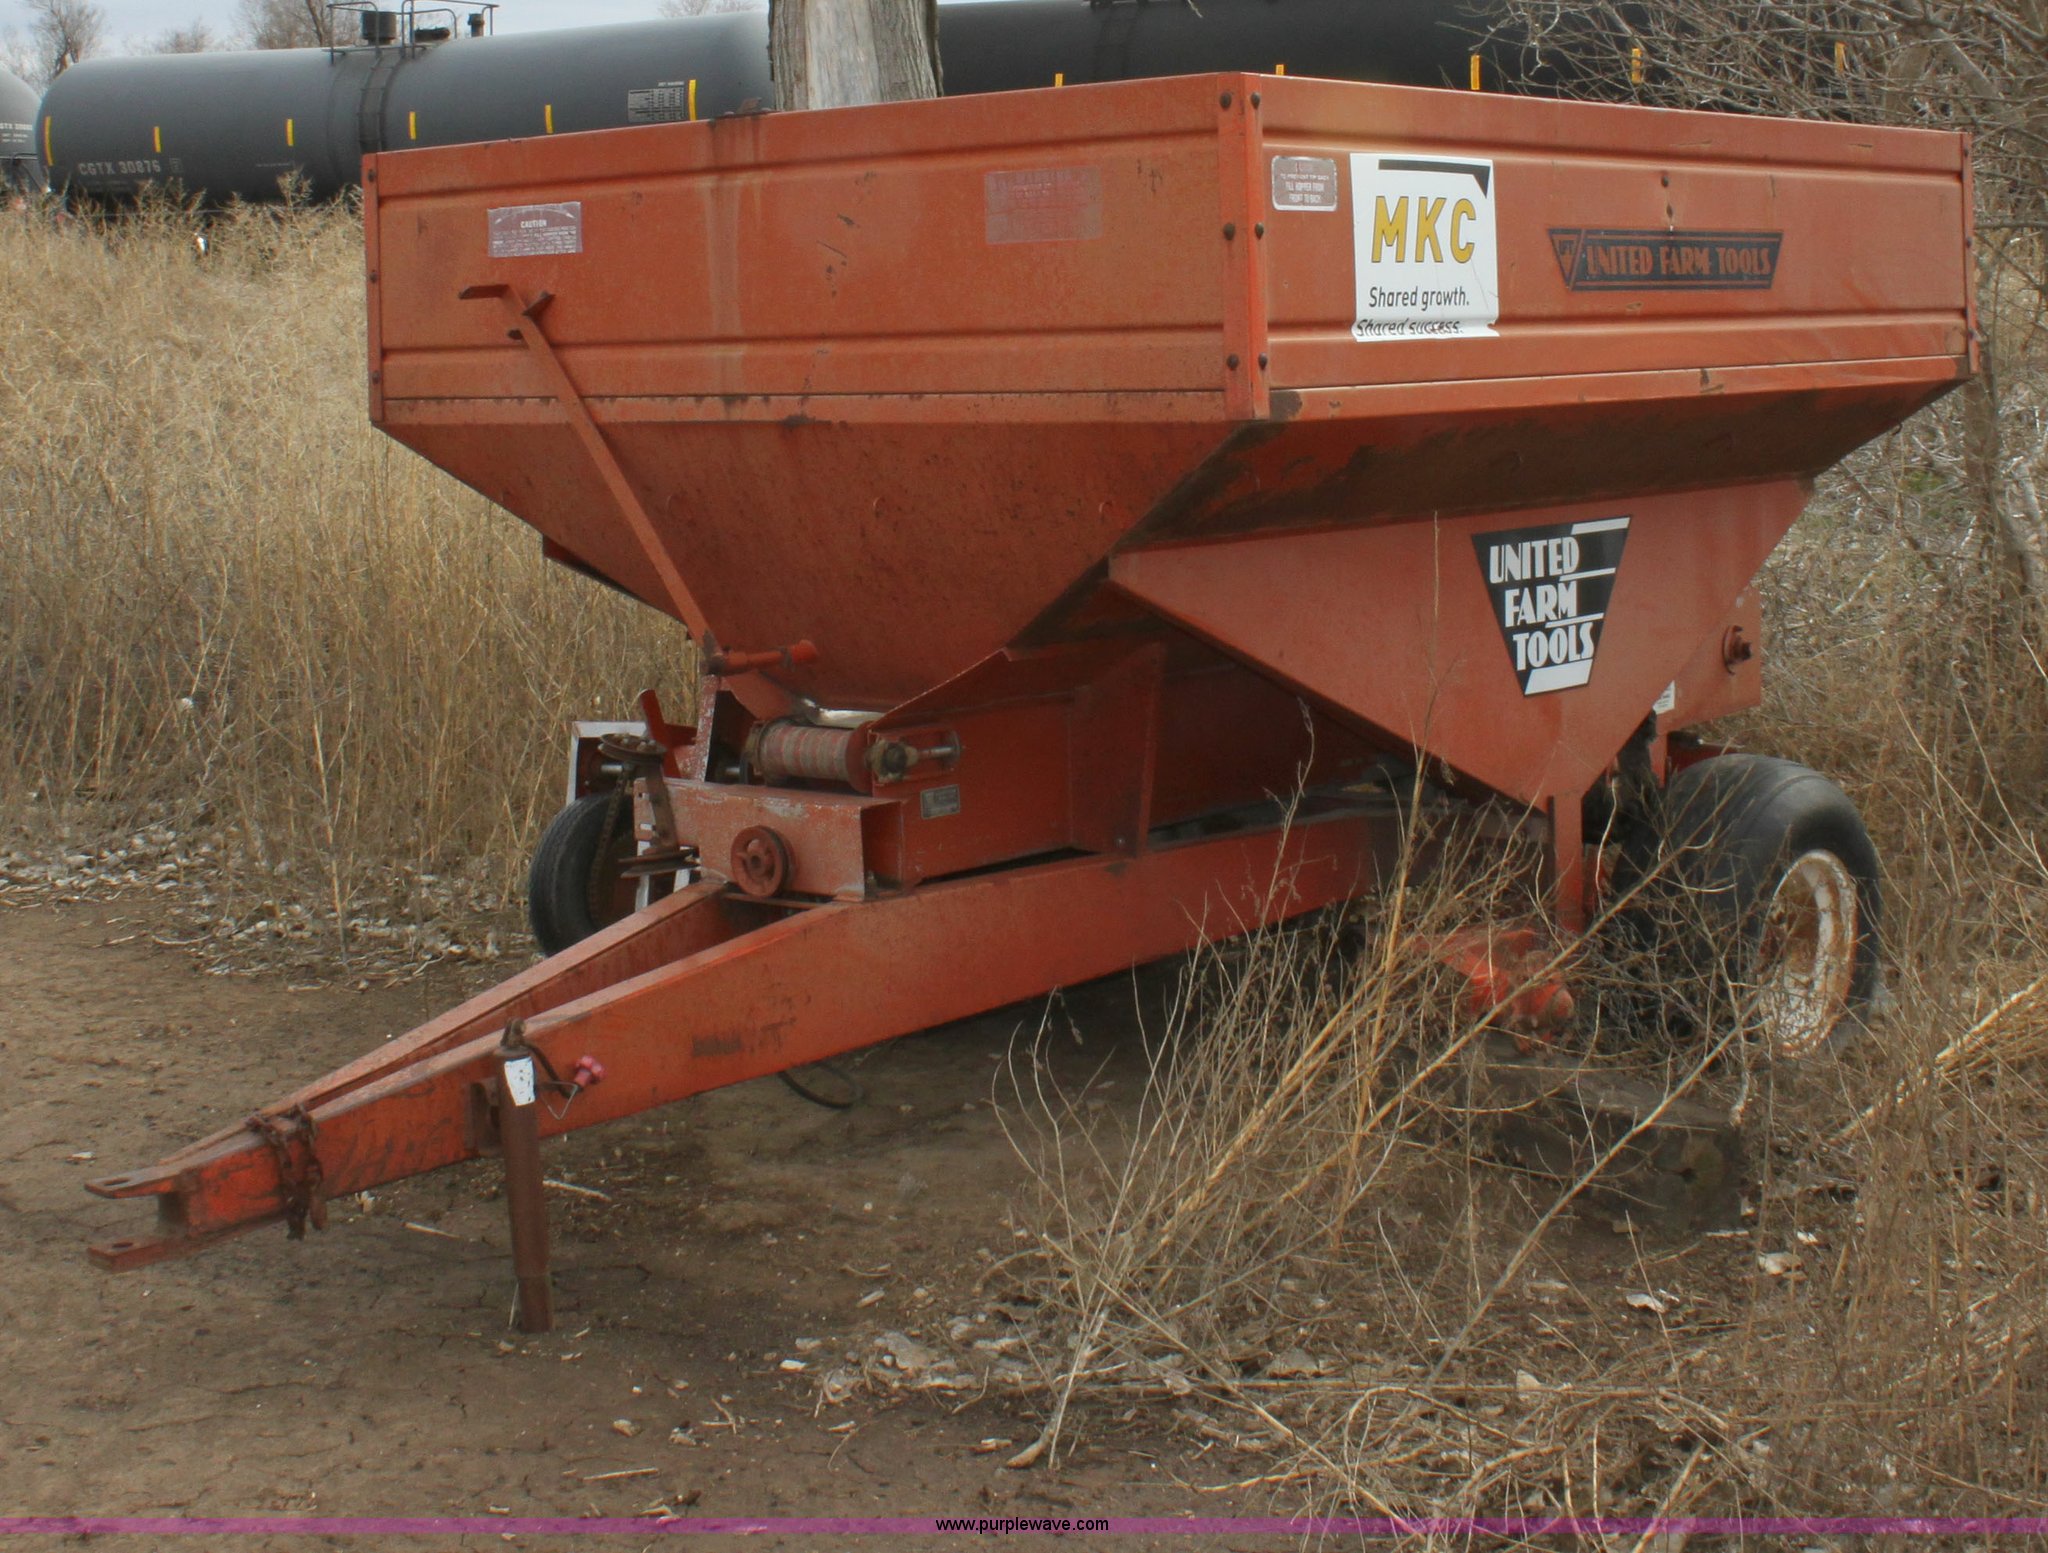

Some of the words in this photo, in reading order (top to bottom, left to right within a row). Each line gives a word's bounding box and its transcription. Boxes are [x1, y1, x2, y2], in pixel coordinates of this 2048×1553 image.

[79, 161, 116, 176] CGTX
[520, 219, 547, 229] CAUTION
[1371, 196, 1476, 264] MKC
[1586, 245, 1654, 276] UNITED
[1659, 246, 1710, 276] FARM
[1717, 247, 1773, 276] TOOLS
[1369, 286, 1418, 308] Shared
[1421, 286, 1470, 311] growth.
[1356, 317, 1409, 337] Shared
[1409, 319, 1464, 337] success.
[1489, 536, 1580, 584] UNITED
[1504, 580, 1578, 628] FARM
[1513, 622, 1595, 671] TOOLS
